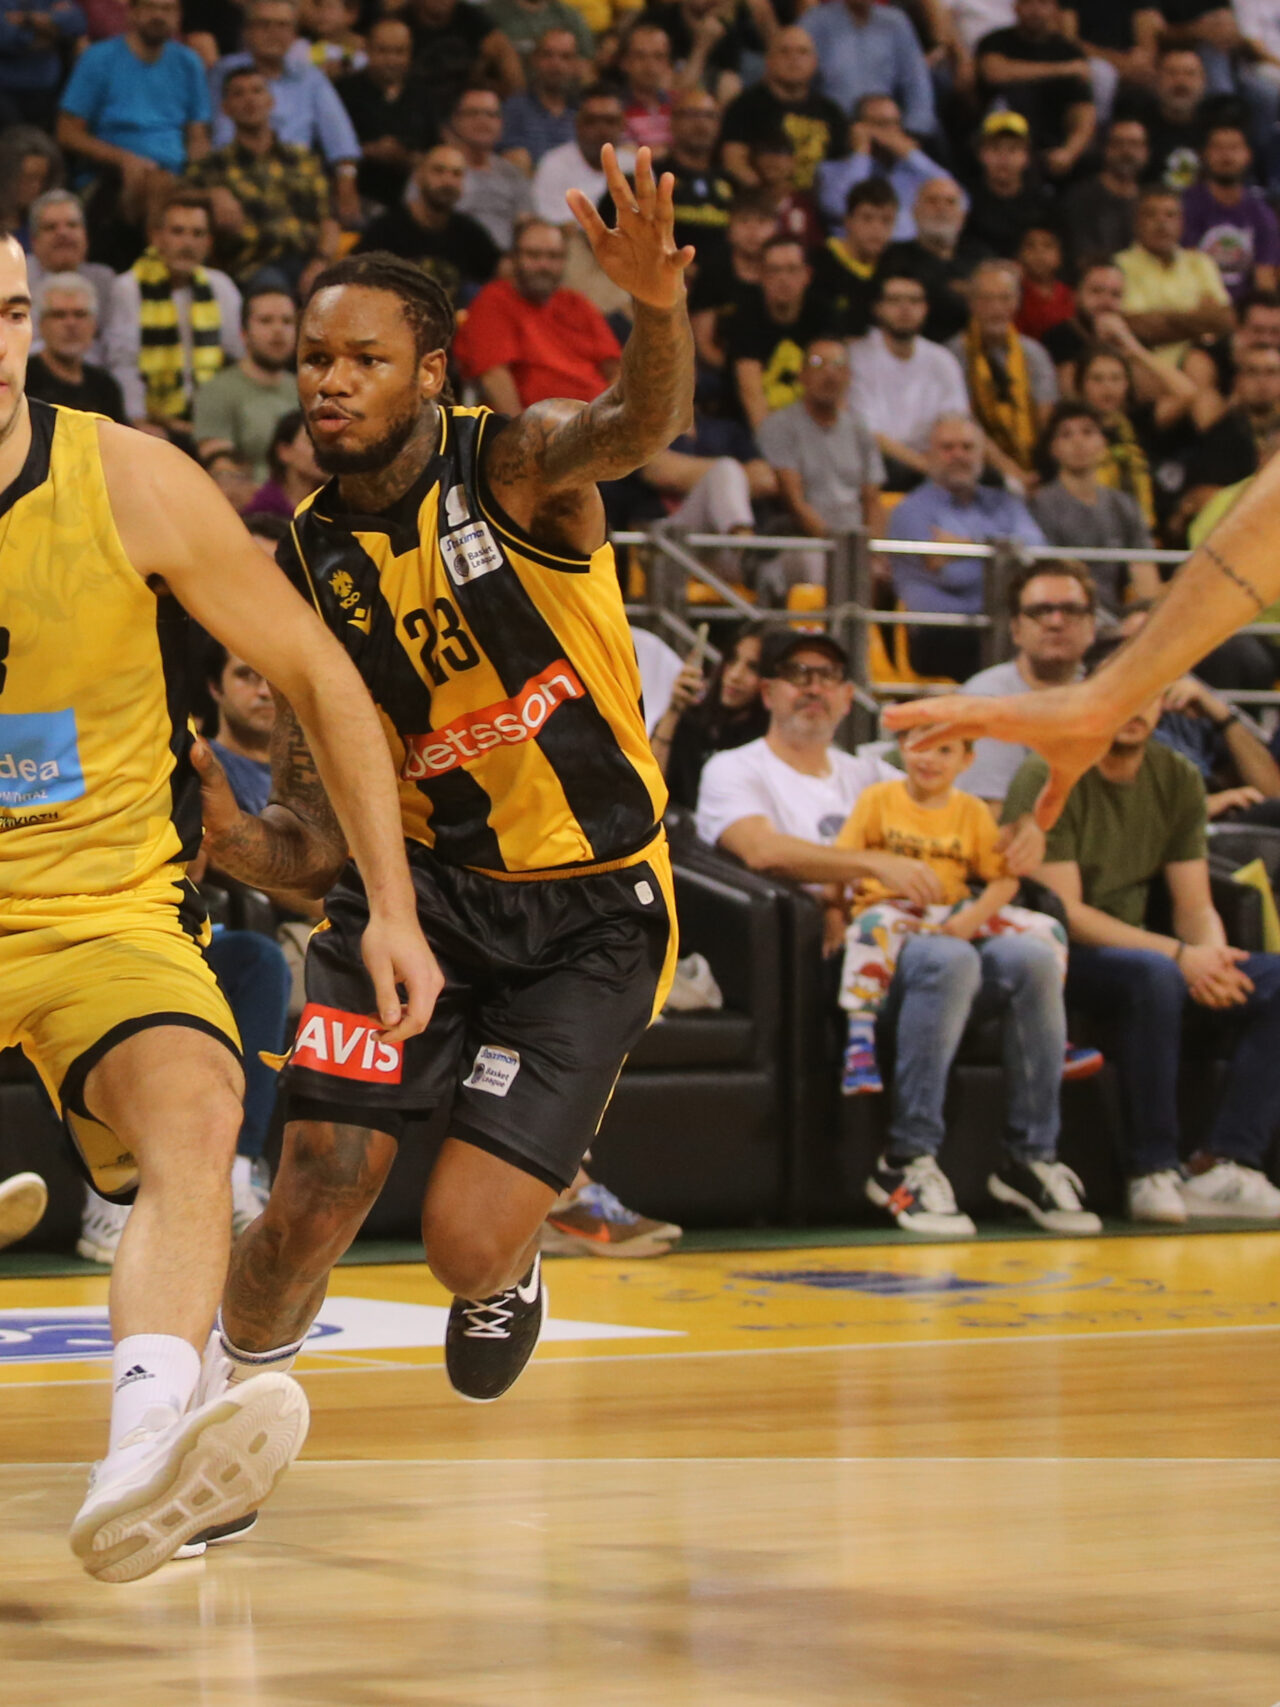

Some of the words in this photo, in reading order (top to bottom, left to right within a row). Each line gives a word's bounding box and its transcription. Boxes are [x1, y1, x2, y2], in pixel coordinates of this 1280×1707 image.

[402, 597, 480, 686] 23
[405, 674, 577, 777] betsson
[295, 1015, 400, 1073] AVIS
